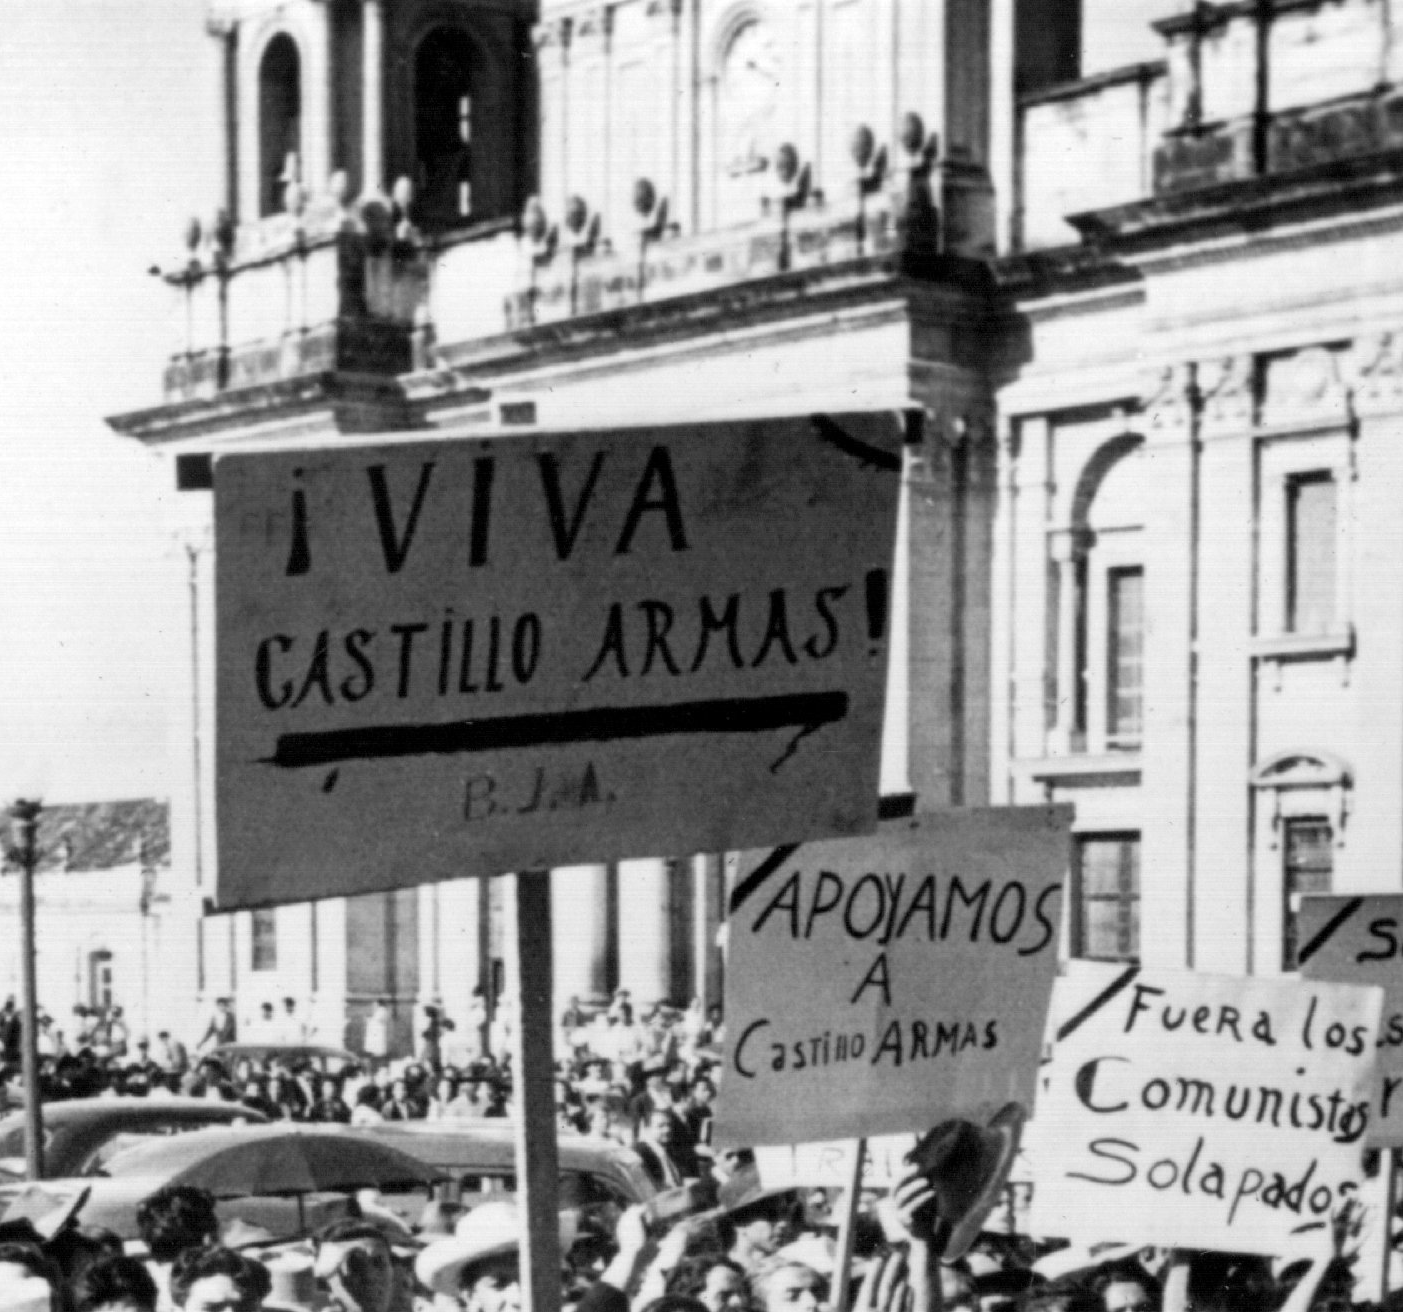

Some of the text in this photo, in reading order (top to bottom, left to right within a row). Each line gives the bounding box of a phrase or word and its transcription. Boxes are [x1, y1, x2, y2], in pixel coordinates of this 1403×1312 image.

[751, 870, 1064, 956] APOYAMOS
[850, 951, 892, 1007] A
[870, 1018, 999, 1068] ARMAS
[1302, 995, 1368, 1057] los
